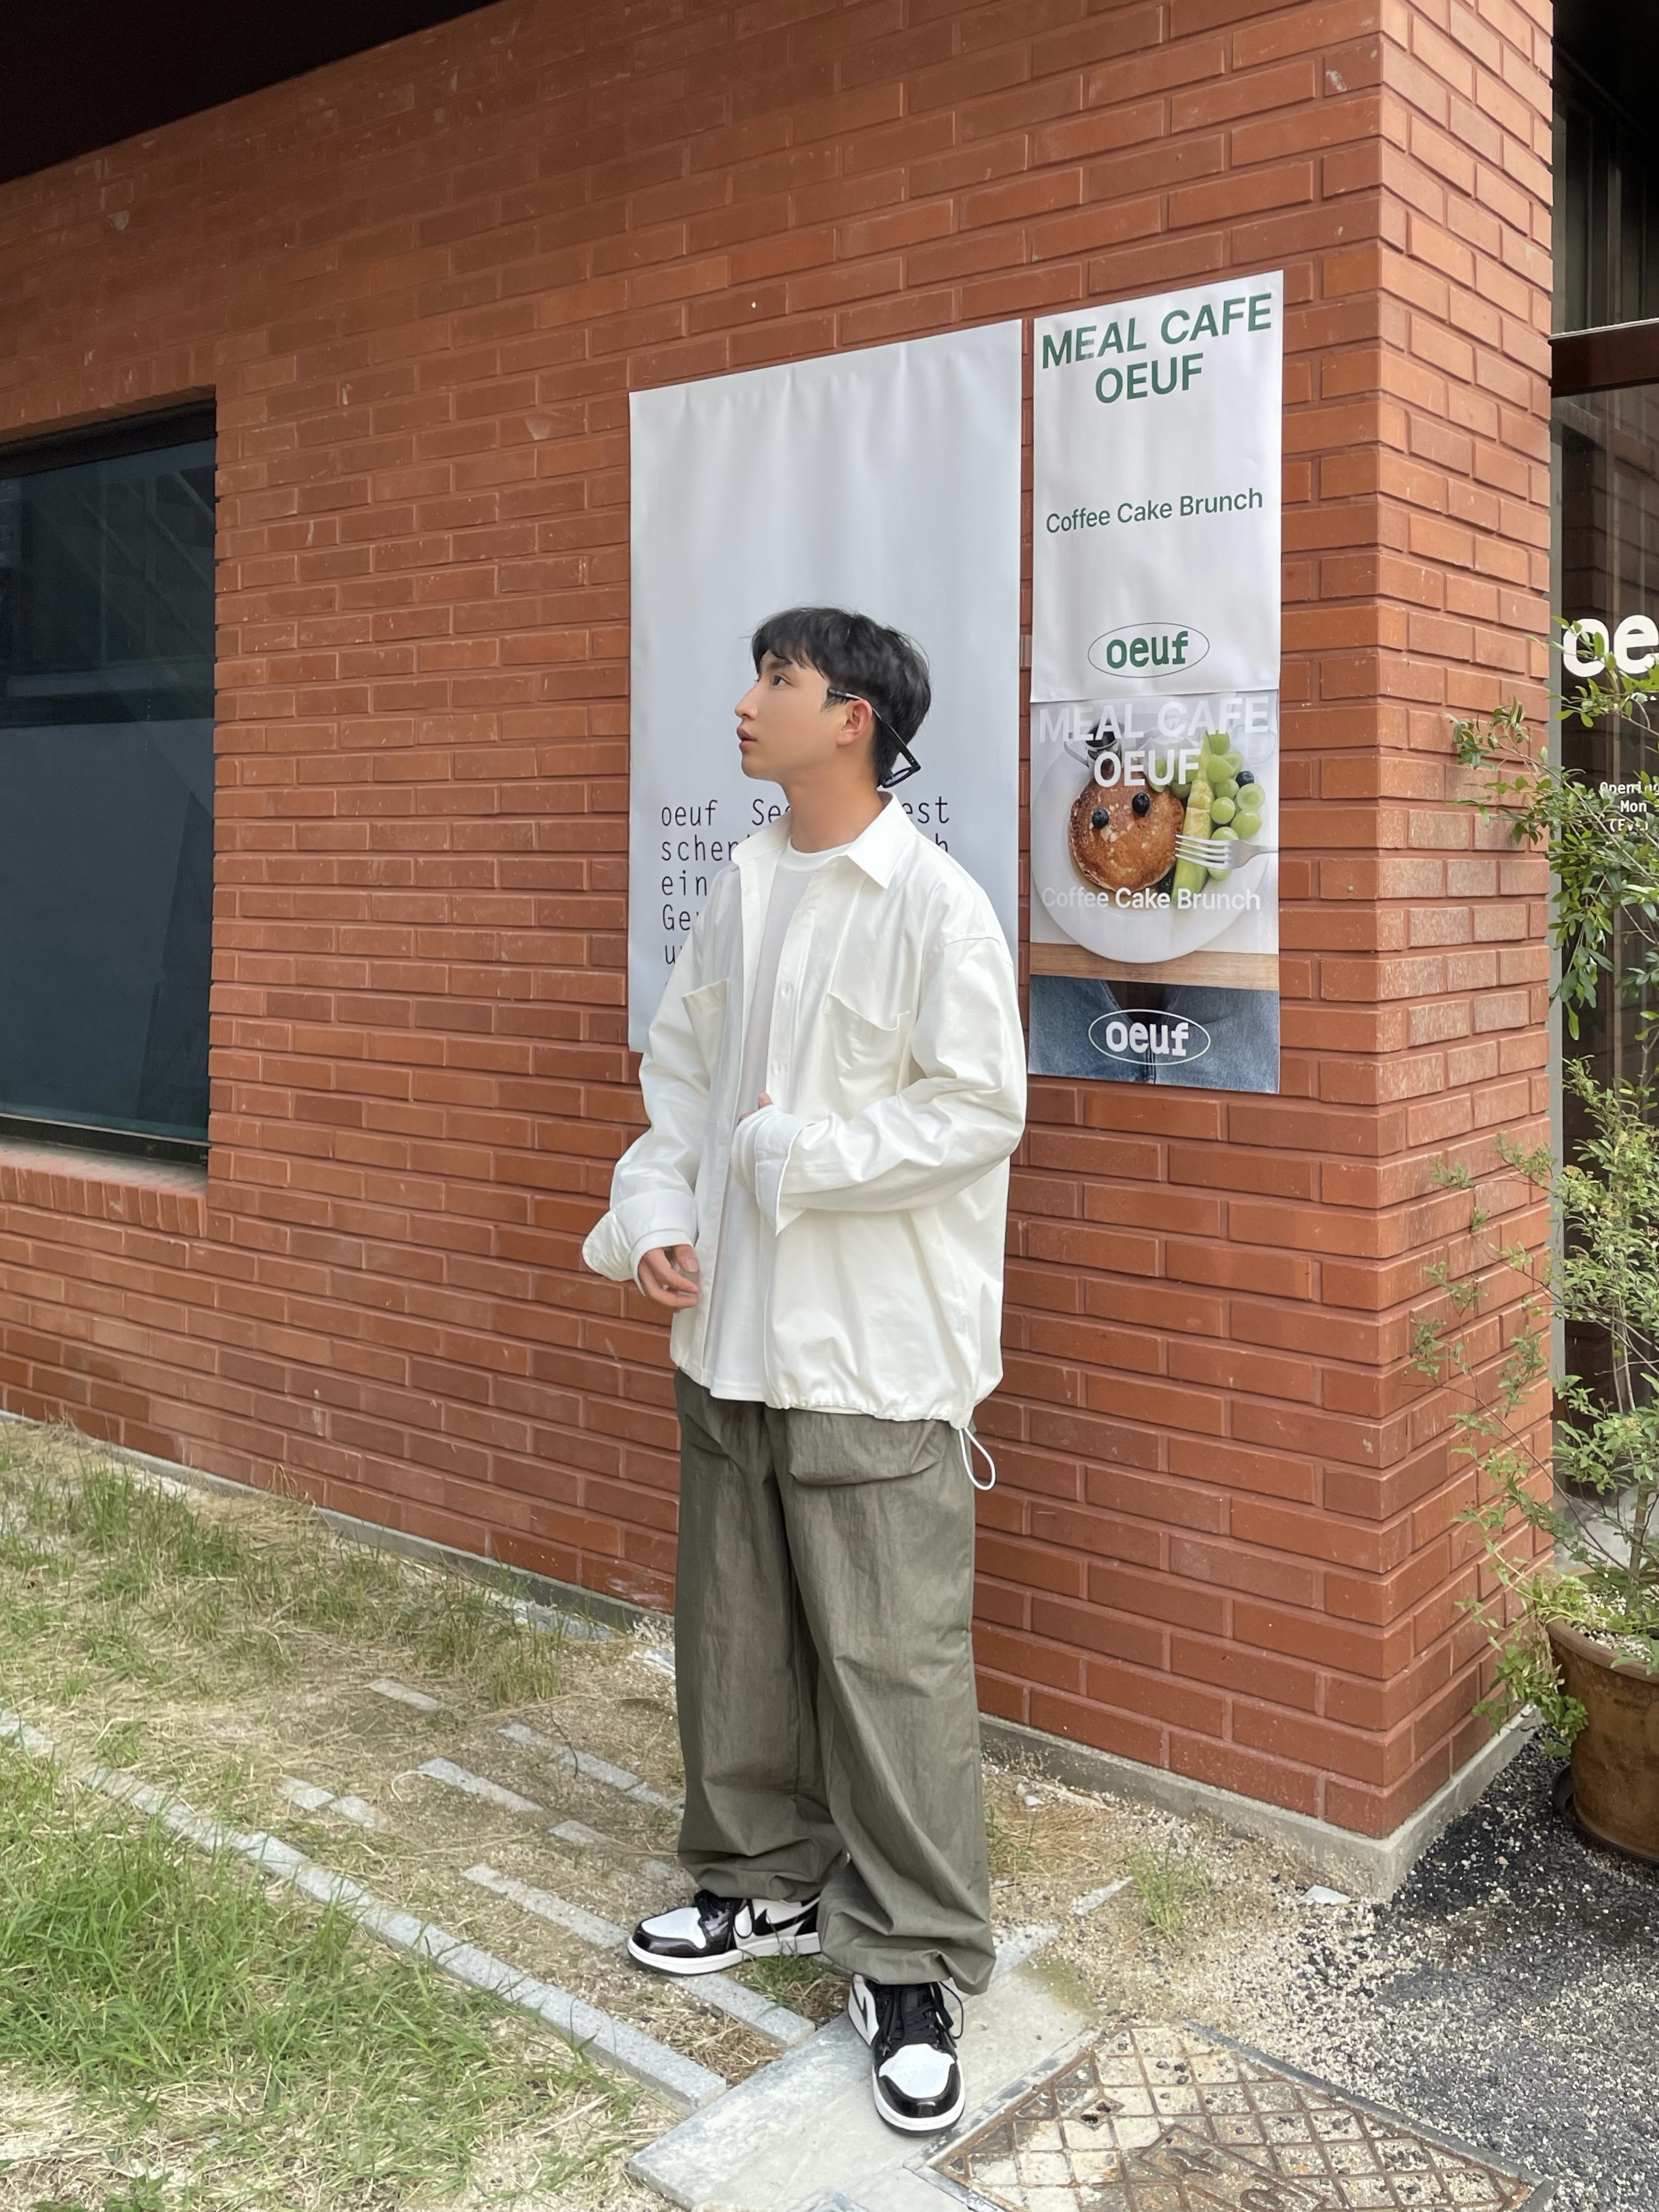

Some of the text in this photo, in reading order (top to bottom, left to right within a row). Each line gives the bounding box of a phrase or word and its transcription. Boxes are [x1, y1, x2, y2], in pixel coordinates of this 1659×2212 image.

[1042, 292, 1272, 369] MEAL CAFE
[1095, 353, 1204, 404] OEUF
[1046, 487, 1263, 533] Coffee Cake Brunch
[1106, 631, 1189, 669] oeuf
[1039, 696, 1269, 743] MEAL CAFE
[1094, 748, 1202, 787] OEUF
[661, 799, 718, 826] oeuf
[1620, 799, 1647, 813] Mon
[661, 834, 751, 862] sche
[661, 869, 708, 896] ein
[1042, 887, 1261, 910] Coffee Cake Brunch
[663, 904, 699, 930] Ge
[1106, 1021, 1189, 1057] oeuf
